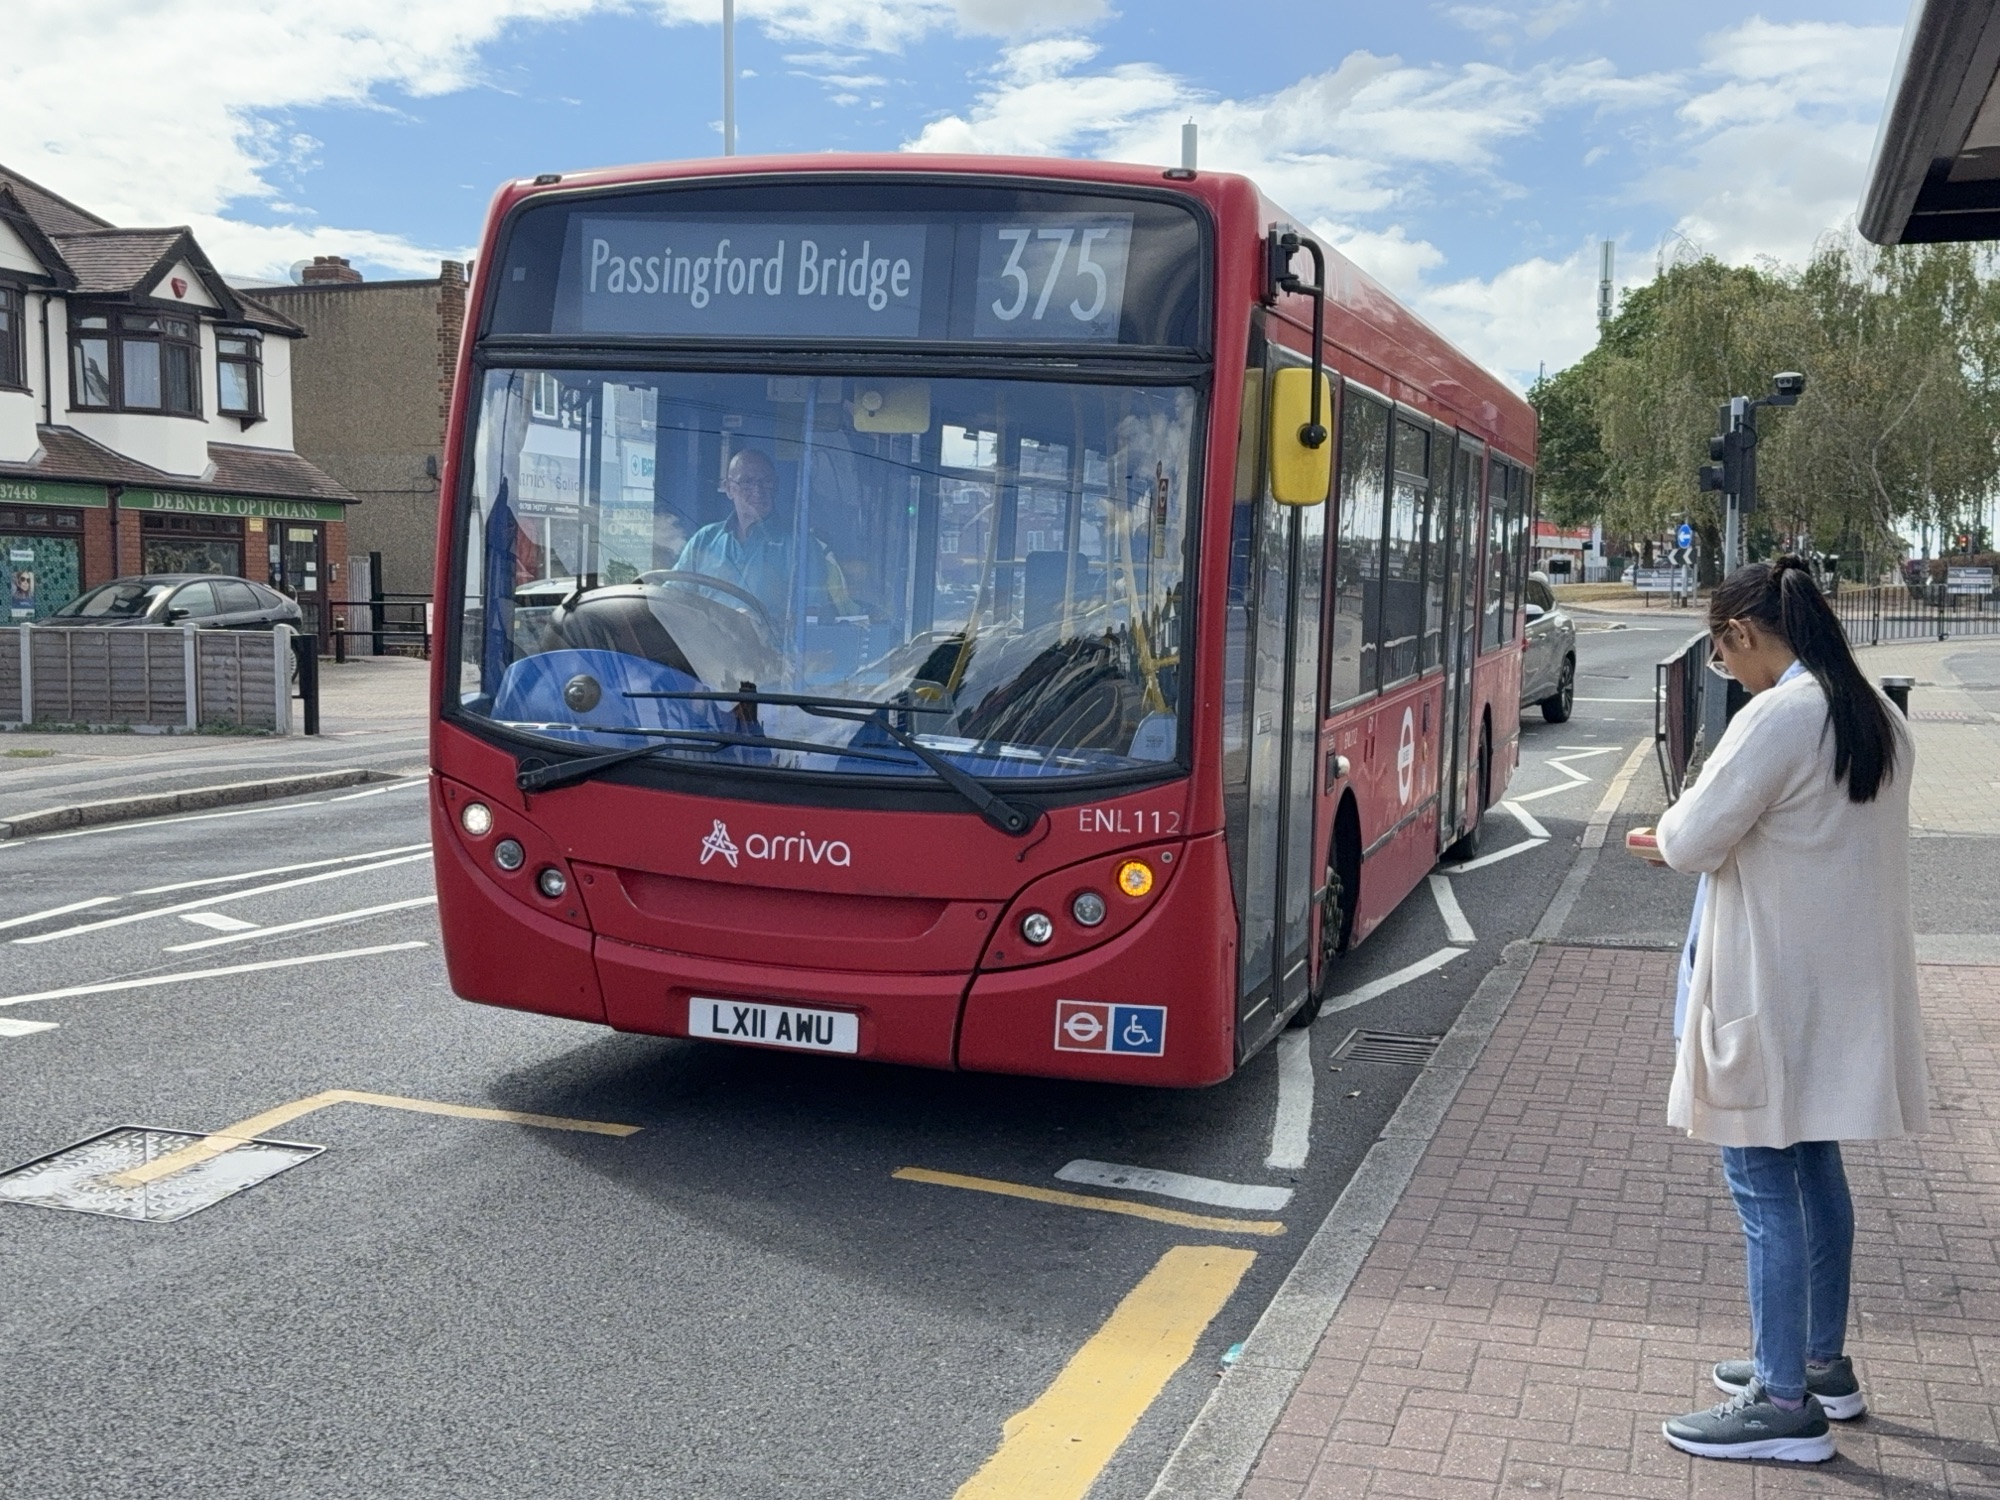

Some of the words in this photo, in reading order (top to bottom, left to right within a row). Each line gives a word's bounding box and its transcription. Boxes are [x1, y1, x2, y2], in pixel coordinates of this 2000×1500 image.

[590, 239, 784, 308] Passingford
[798, 240, 910, 311] Bridge
[992, 229, 1110, 321] 375
[0, 483, 37, 500] 37448
[152, 492, 230, 513] DEBNEY'S
[236, 499, 317, 518] OPTICIANS
[1079, 809, 1180, 834] ENL112
[746, 830, 850, 867] arriva
[713, 1004, 766, 1038] LX11
[775, 1012, 834, 1045] AWU
